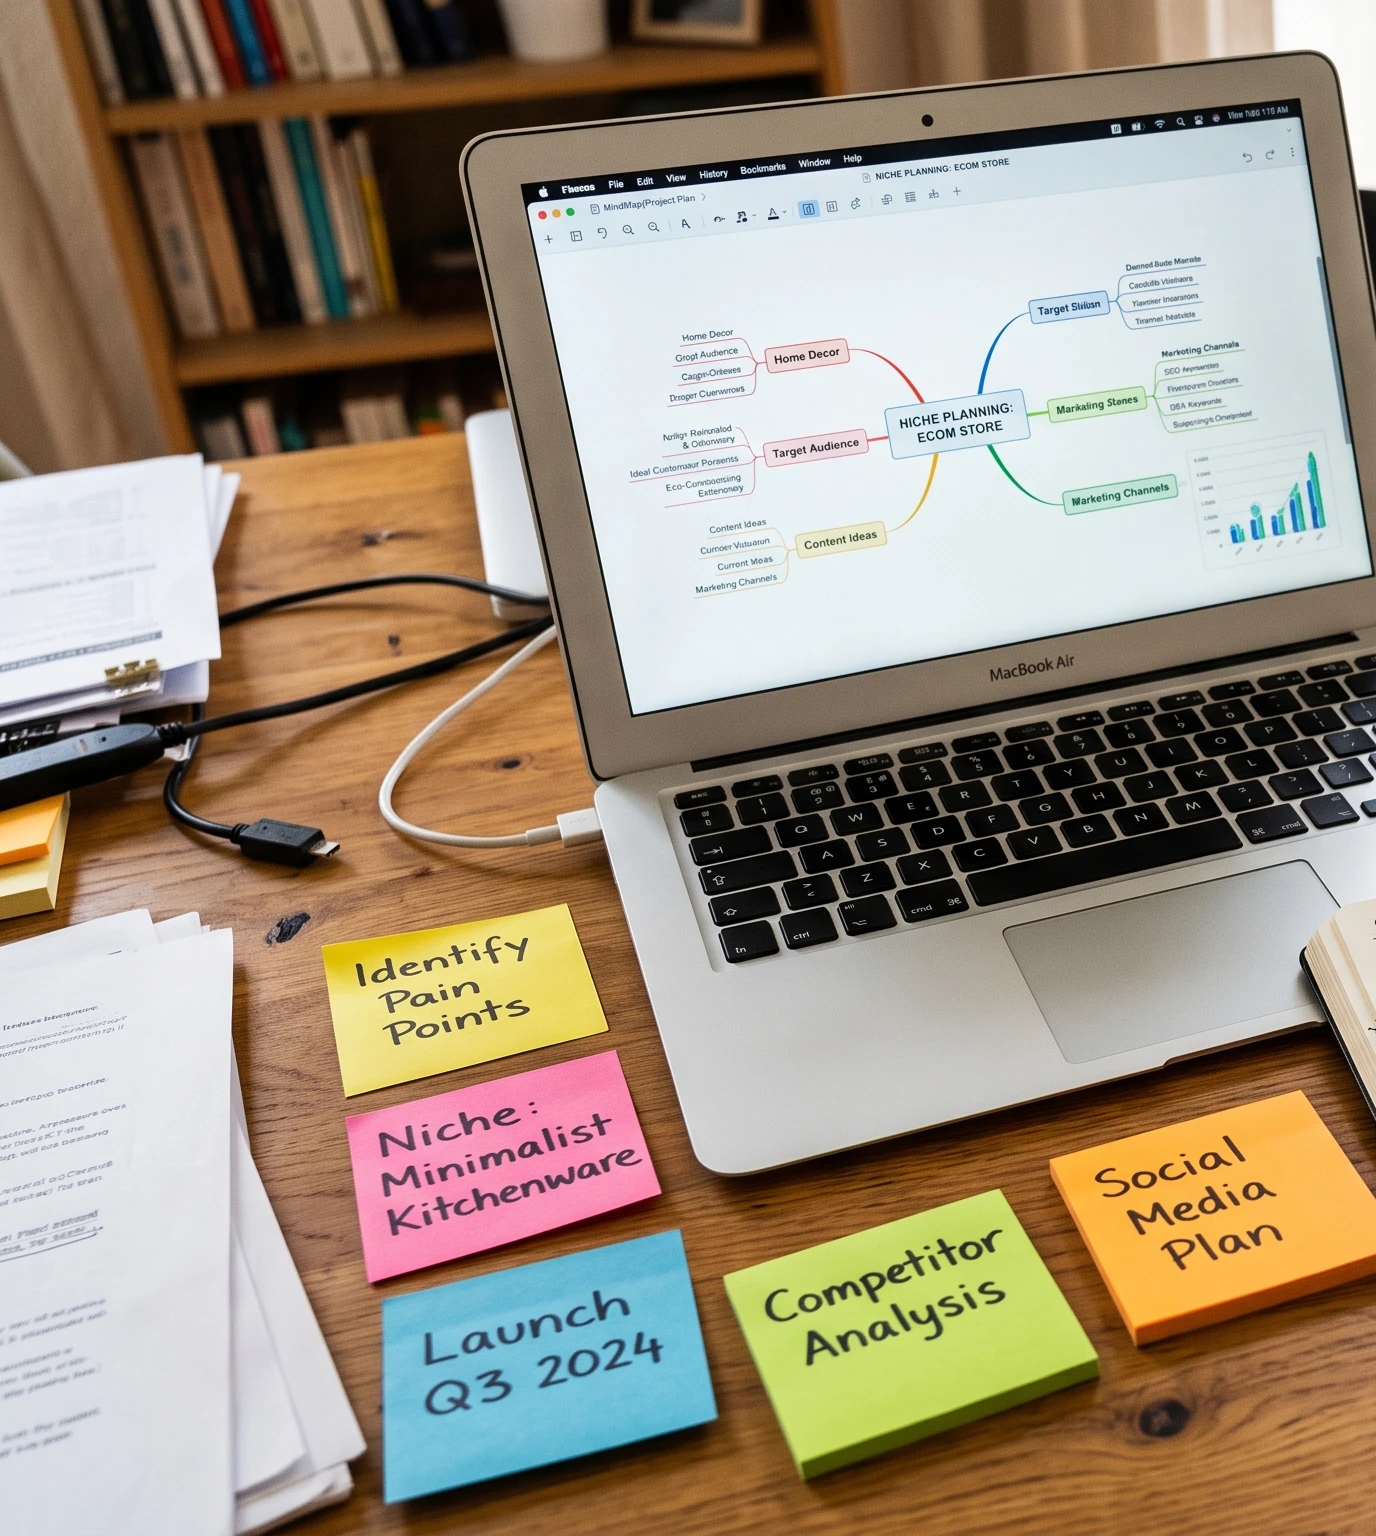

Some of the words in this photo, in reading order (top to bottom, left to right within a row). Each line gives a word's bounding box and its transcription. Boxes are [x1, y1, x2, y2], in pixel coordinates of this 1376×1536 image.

[666, 174, 688, 184] View
[700, 170, 728, 181] History
[798, 157, 832, 170] Window
[843, 154, 863, 166] Help
[876, 170, 903, 181] NICHE
[904, 165, 952, 178] PLANNING:
[954, 161, 980, 173] ECOM
[981, 157, 1011, 169] STORE
[1037, 304, 1071, 317] Target
[682, 333, 708, 343] Home
[709, 330, 735, 340] Decor
[774, 351, 807, 366] Home
[809, 346, 841, 361] Decor
[942, 402, 1014, 423] PLANNING:
[917, 427, 956, 443] ECOM
[959, 420, 1003, 437] STORE
[773, 446, 808, 463] Target
[809, 439, 861, 456] Audience
[1071, 490, 1122, 508] Marketing
[1123, 483, 1170, 500] Channels
[709, 523, 743, 535] Content
[744, 519, 768, 530] Ideas
[804, 535, 848, 551] Content
[849, 530, 879, 545] Ideas
[695, 581, 738, 594] Marketing
[738, 574, 779, 588] Channels
[989, 657, 1054, 682] MacBook
[1056, 654, 1075, 670] Air
[1114, 757, 1127, 766] U
[959, 790, 971, 799] R
[1091, 791, 1105, 801] H
[1134, 812, 1148, 822] N
[1185, 801, 1201, 811] M
[847, 812, 863, 823] W
[794, 825, 808, 834] Q
[932, 826, 945, 836] D
[1082, 824, 1094, 834] B
[822, 850, 834, 860] A
[918, 860, 931, 871] X
[793, 929, 811, 941] ctrl
[355, 935, 529, 987] Identify
[377, 981, 481, 1014] Pain
[382, 999, 532, 1046] Points
[378, 1101, 538, 1158] Niche:
[381, 1113, 613, 1198] Minimalist
[1094, 1134, 1247, 1198] Social
[387, 1149, 643, 1237] Kitchenware
[1126, 1176, 1277, 1236] Media
[1160, 1222, 1284, 1271] Plan
[764, 1228, 1005, 1323] Competitor
[423, 1289, 632, 1366] Launch
[805, 1279, 1007, 1367] Analysis
[424, 1369, 513, 1416] Q3
[536, 1331, 665, 1389] 2024
